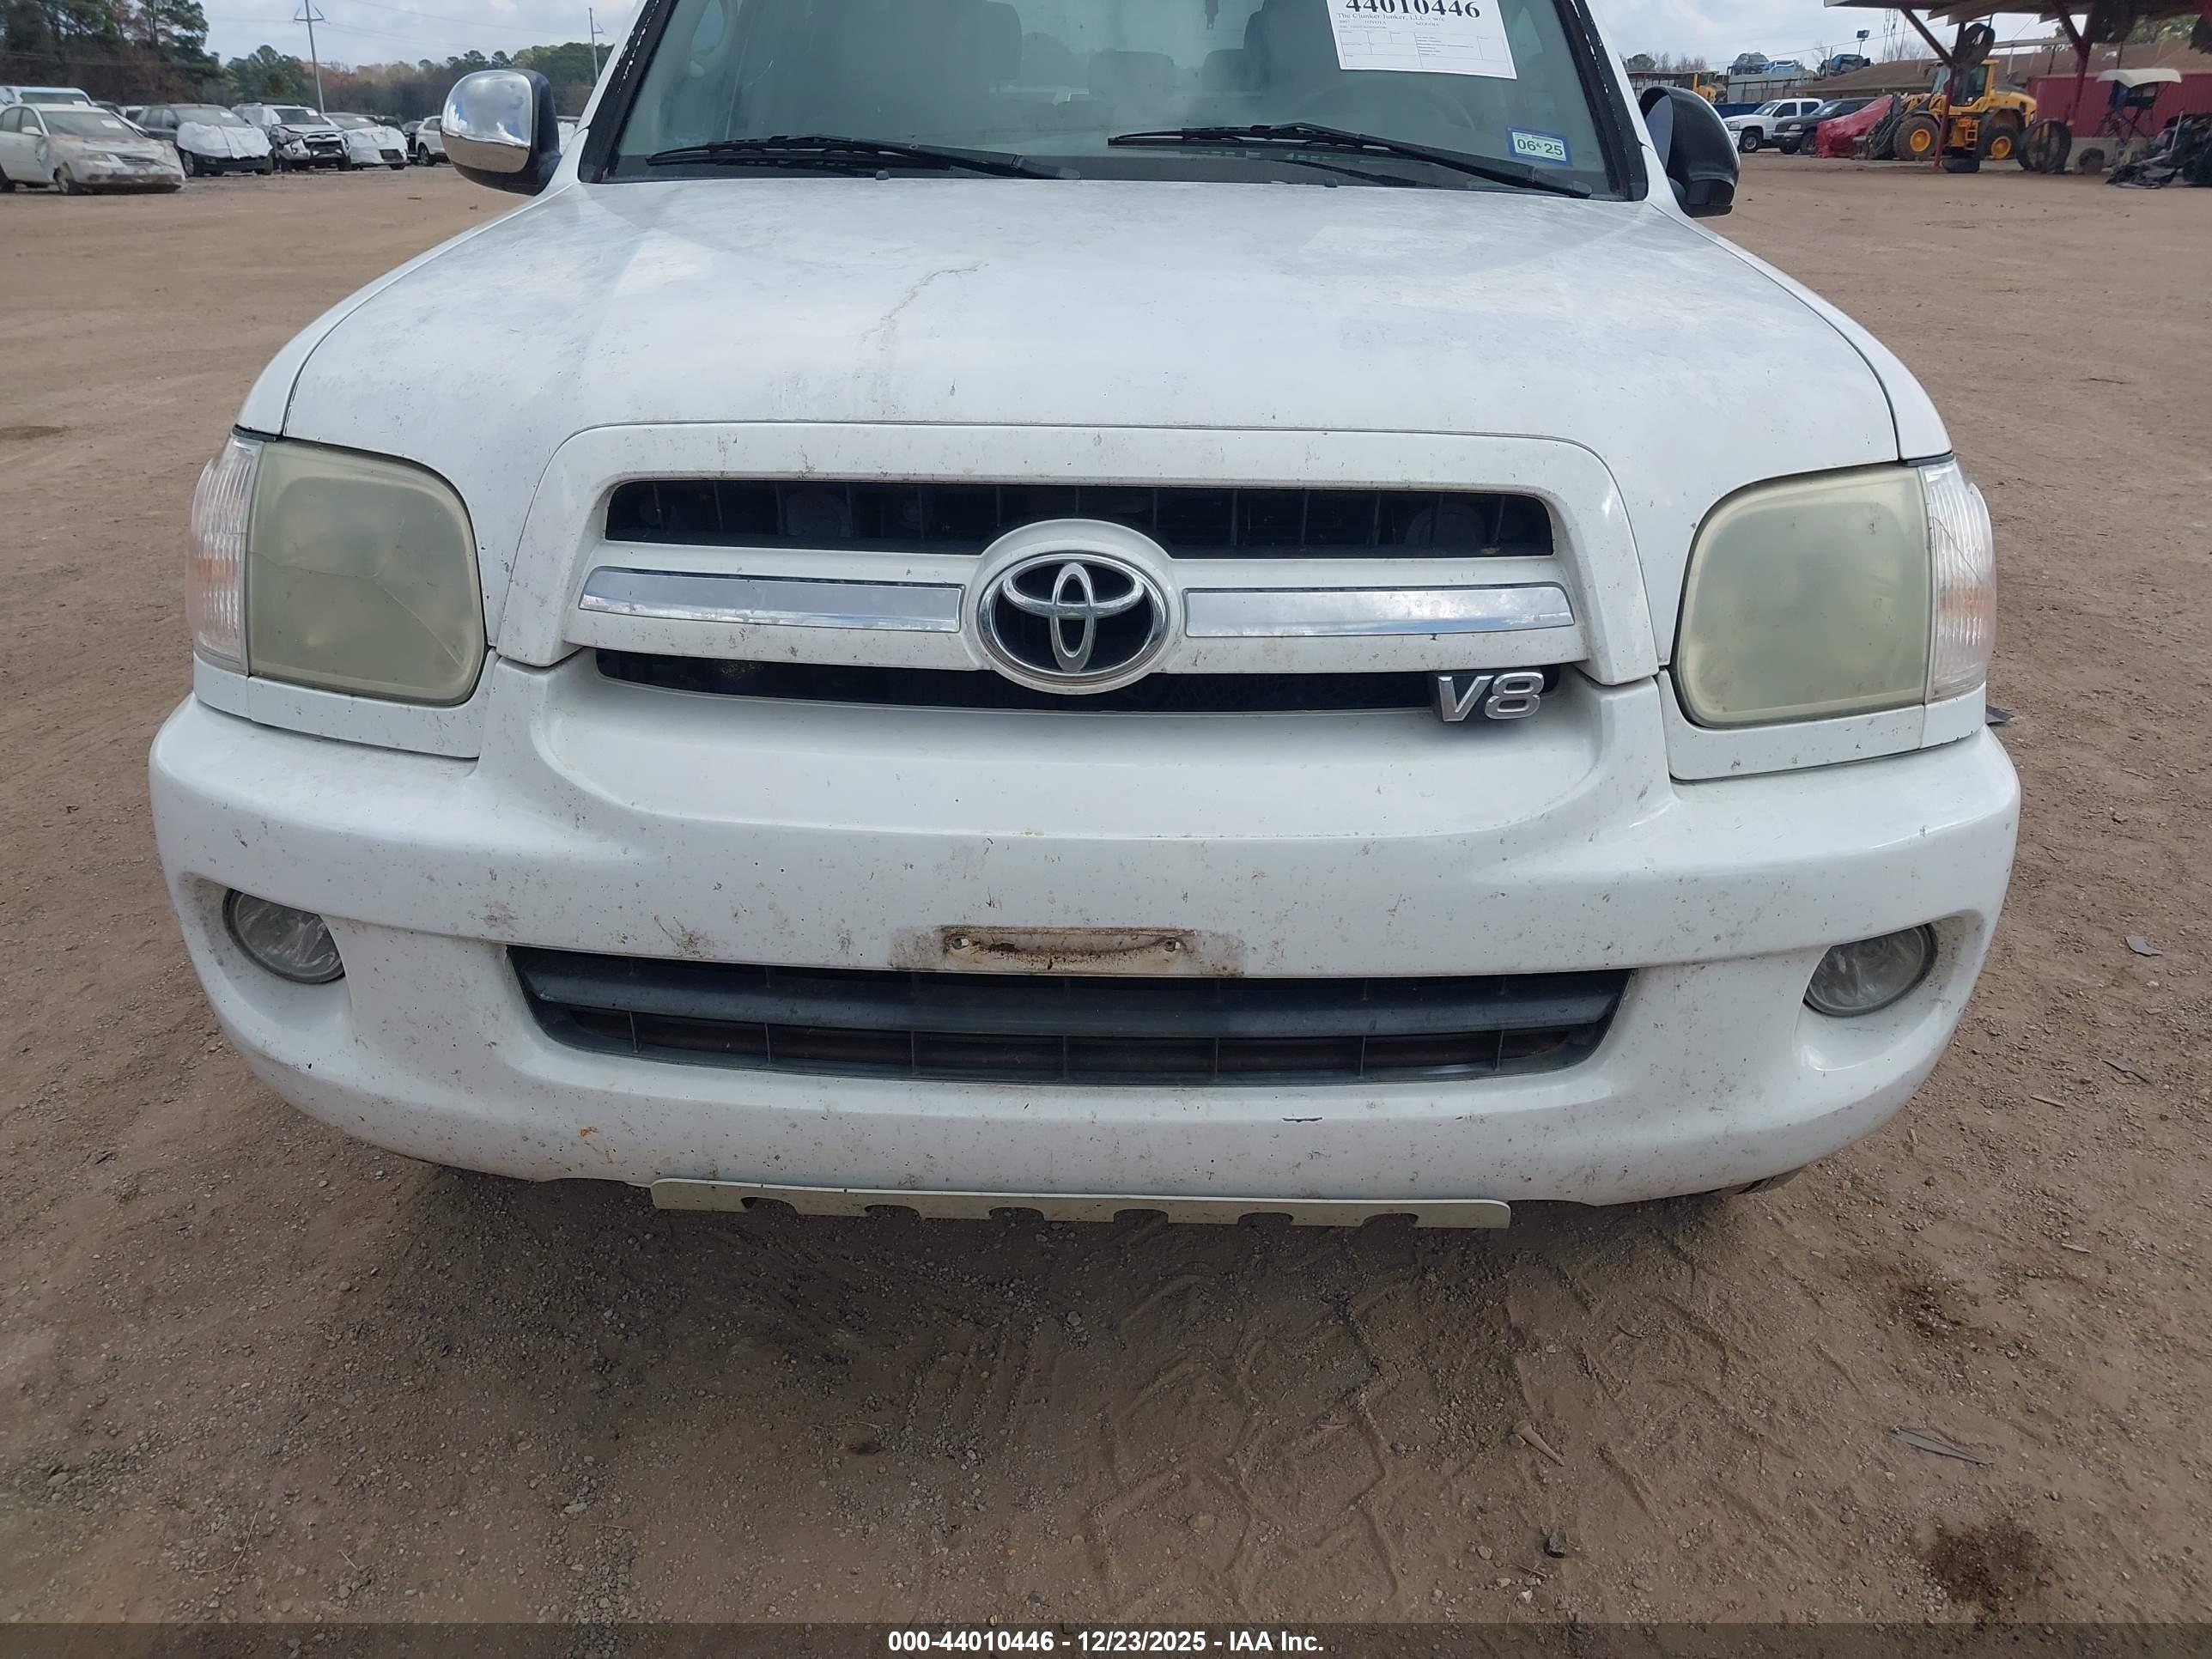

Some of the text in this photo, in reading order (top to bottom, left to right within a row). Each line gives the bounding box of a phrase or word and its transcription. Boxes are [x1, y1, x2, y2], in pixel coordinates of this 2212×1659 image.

[1346, 0, 1480, 18] 44010446
[1517, 139, 1563, 156] 06 25
[1437, 672, 1545, 722] V8
